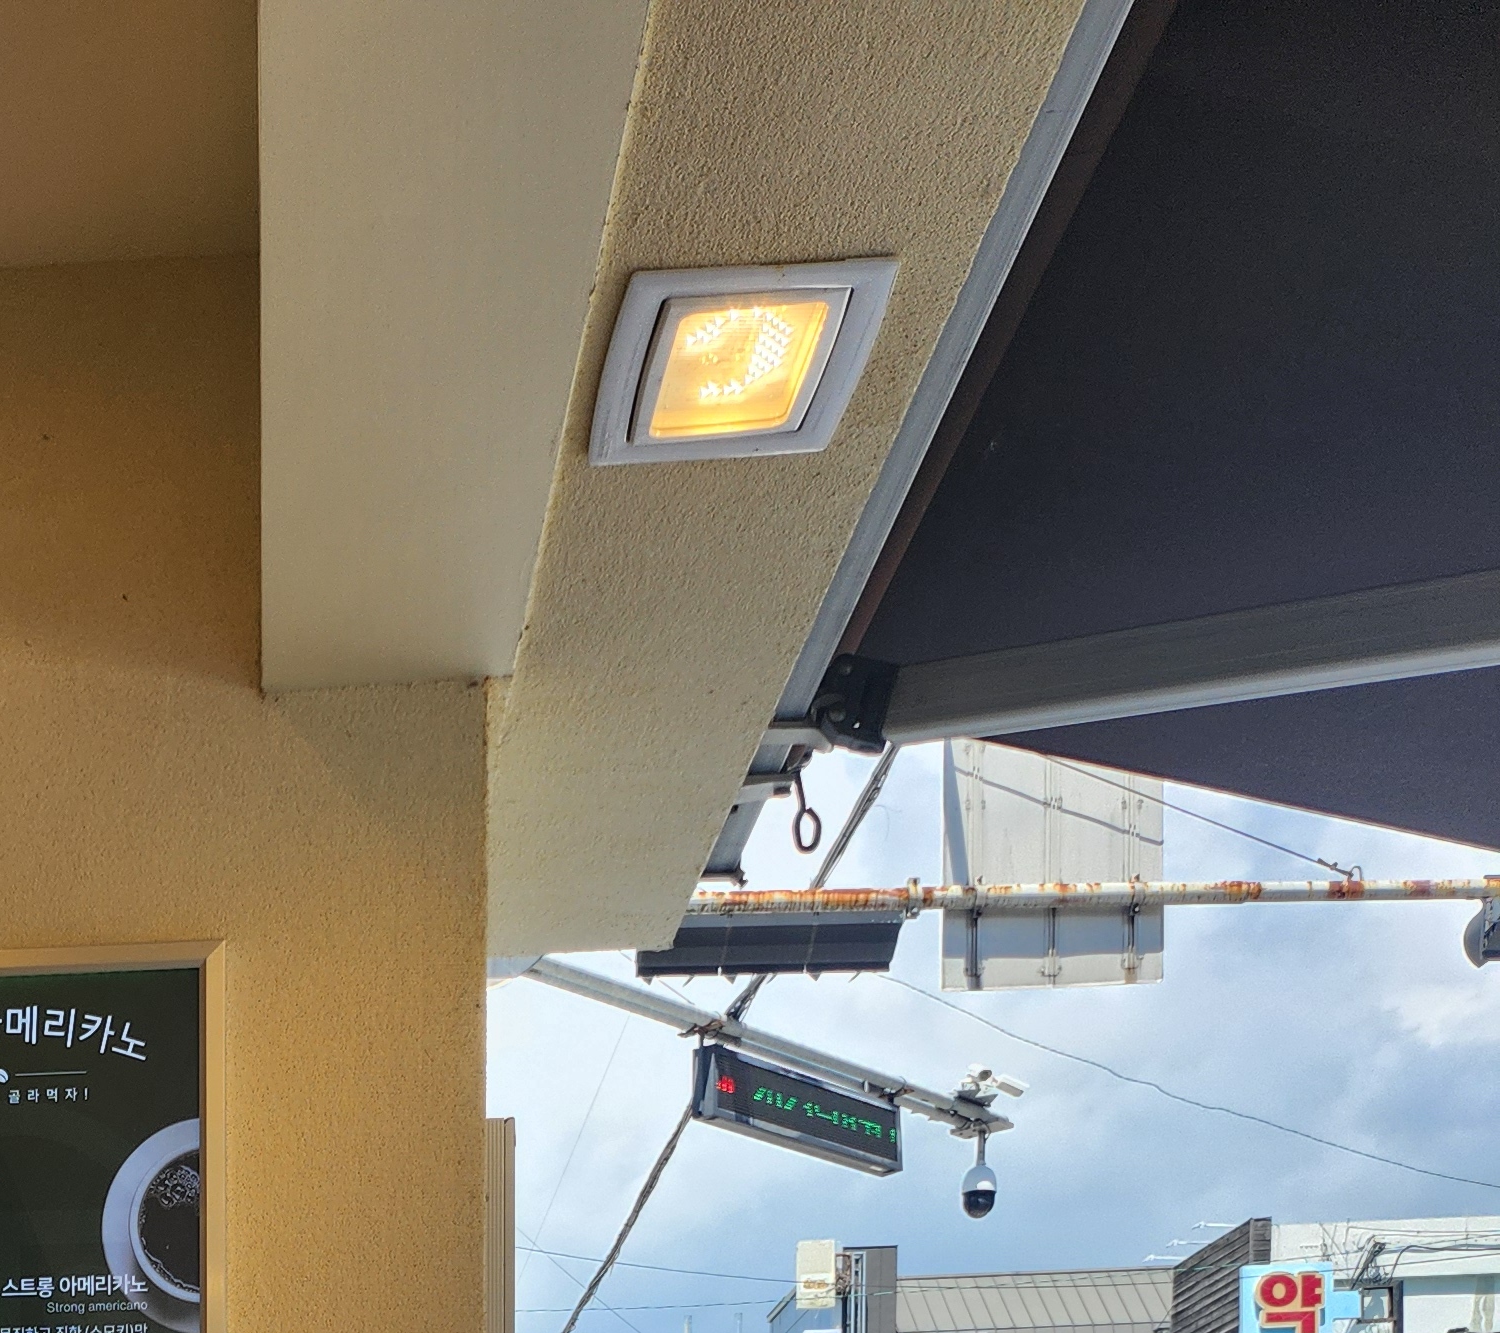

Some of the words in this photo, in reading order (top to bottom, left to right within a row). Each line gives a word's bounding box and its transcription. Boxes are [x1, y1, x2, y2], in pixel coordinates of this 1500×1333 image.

[8, 1088, 89, 1104] 골라먹자!
[1, 1275, 55, 1298] 스트롱
[60, 1274, 148, 1296] 아메리카노
[46, 1301, 85, 1315] Strong
[88, 1300, 148, 1312] americano
